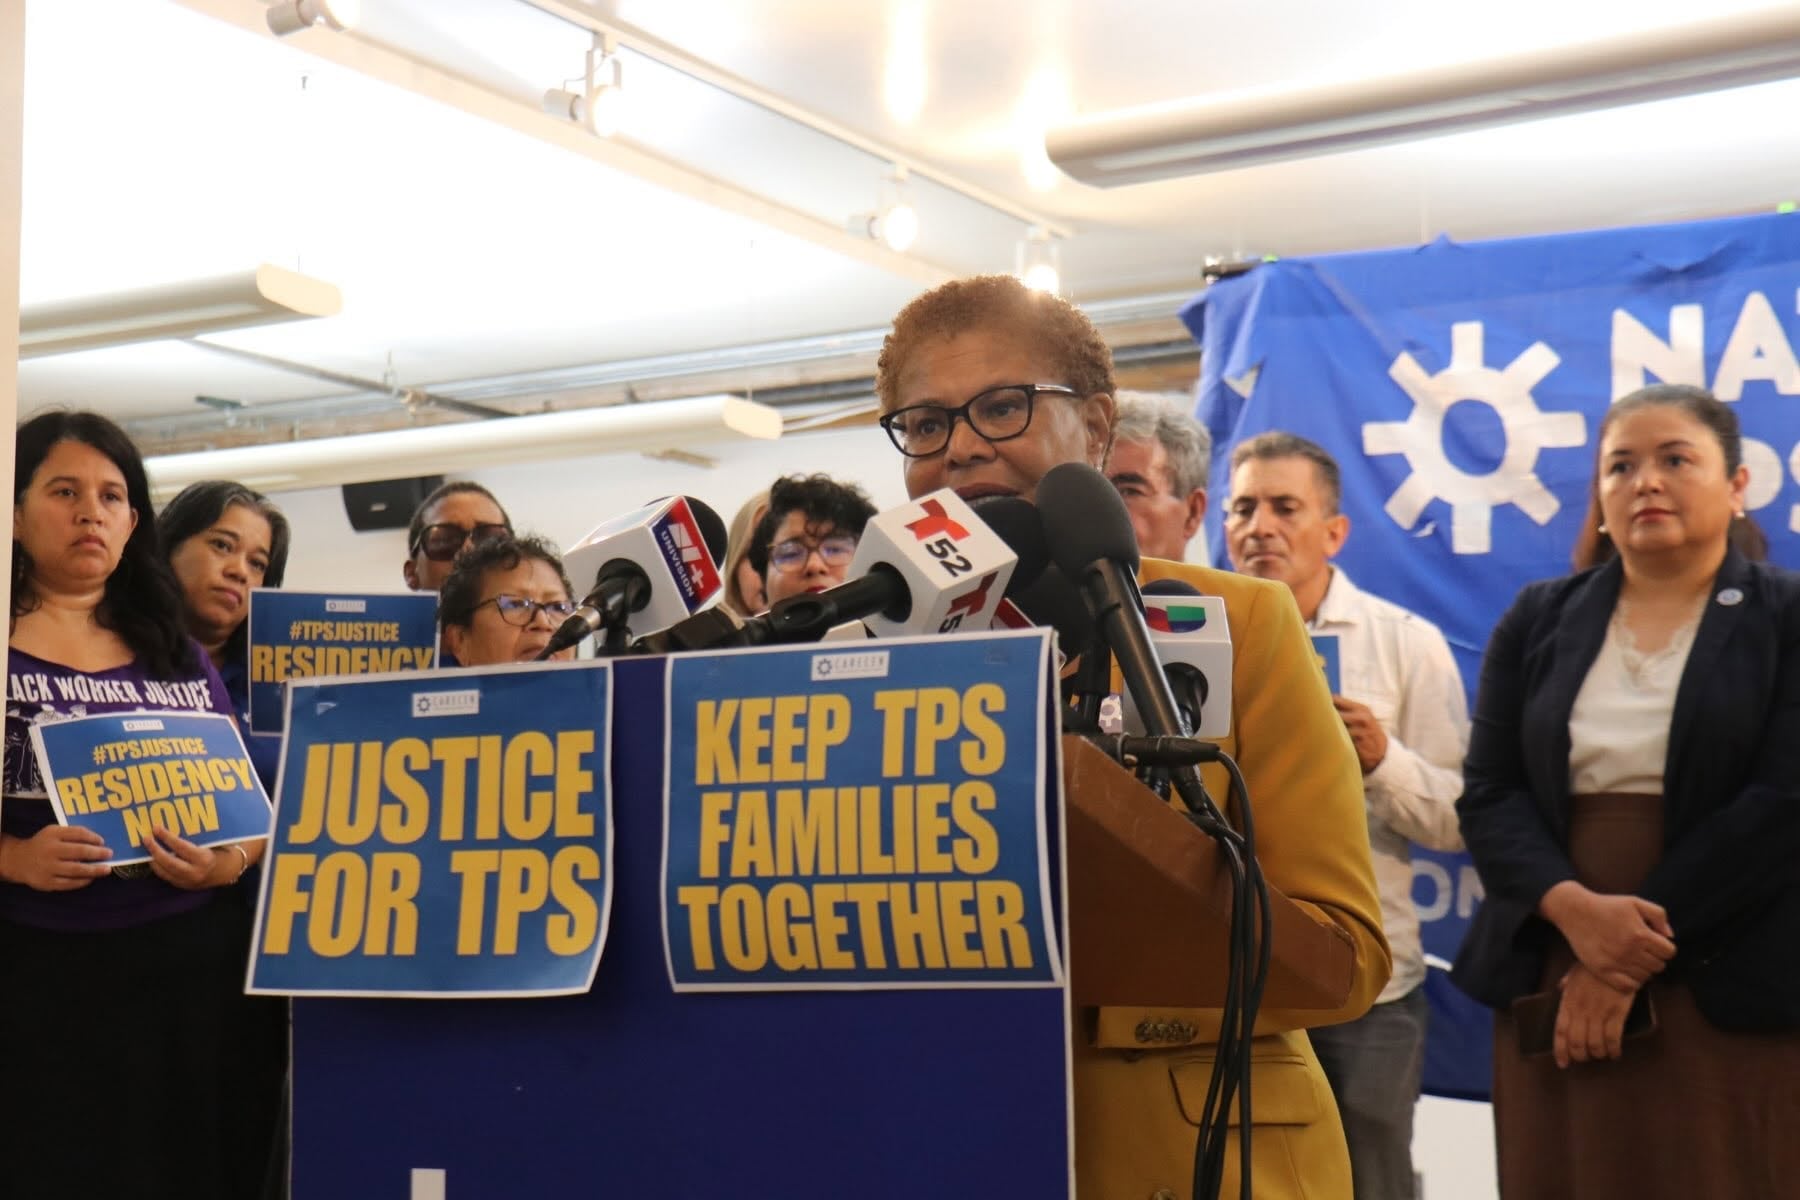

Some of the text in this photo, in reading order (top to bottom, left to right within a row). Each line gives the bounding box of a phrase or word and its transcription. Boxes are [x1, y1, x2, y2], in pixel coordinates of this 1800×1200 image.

[1611, 291, 1800, 402] NA
[660, 530, 695, 598] UNIVISION
[925, 538, 973, 578] 52
[290, 620, 400, 642] #TPSJUSTICE
[938, 613, 964, 634] 5
[6, 673, 214, 709] ACK WORKER JUSTICE
[251, 645, 435, 683] RESIDENCY
[92, 737, 208, 765] #TPSJUSTICE
[695, 682, 1006, 785] KEEP TPS
[55, 757, 254, 816] RESIDENCY
[287, 730, 596, 846] JUSTICE
[121, 794, 220, 848] NOW
[698, 780, 999, 879] FAMILIES
[262, 845, 602, 957] FOR TPS
[677, 879, 1034, 972] TOGETHER
